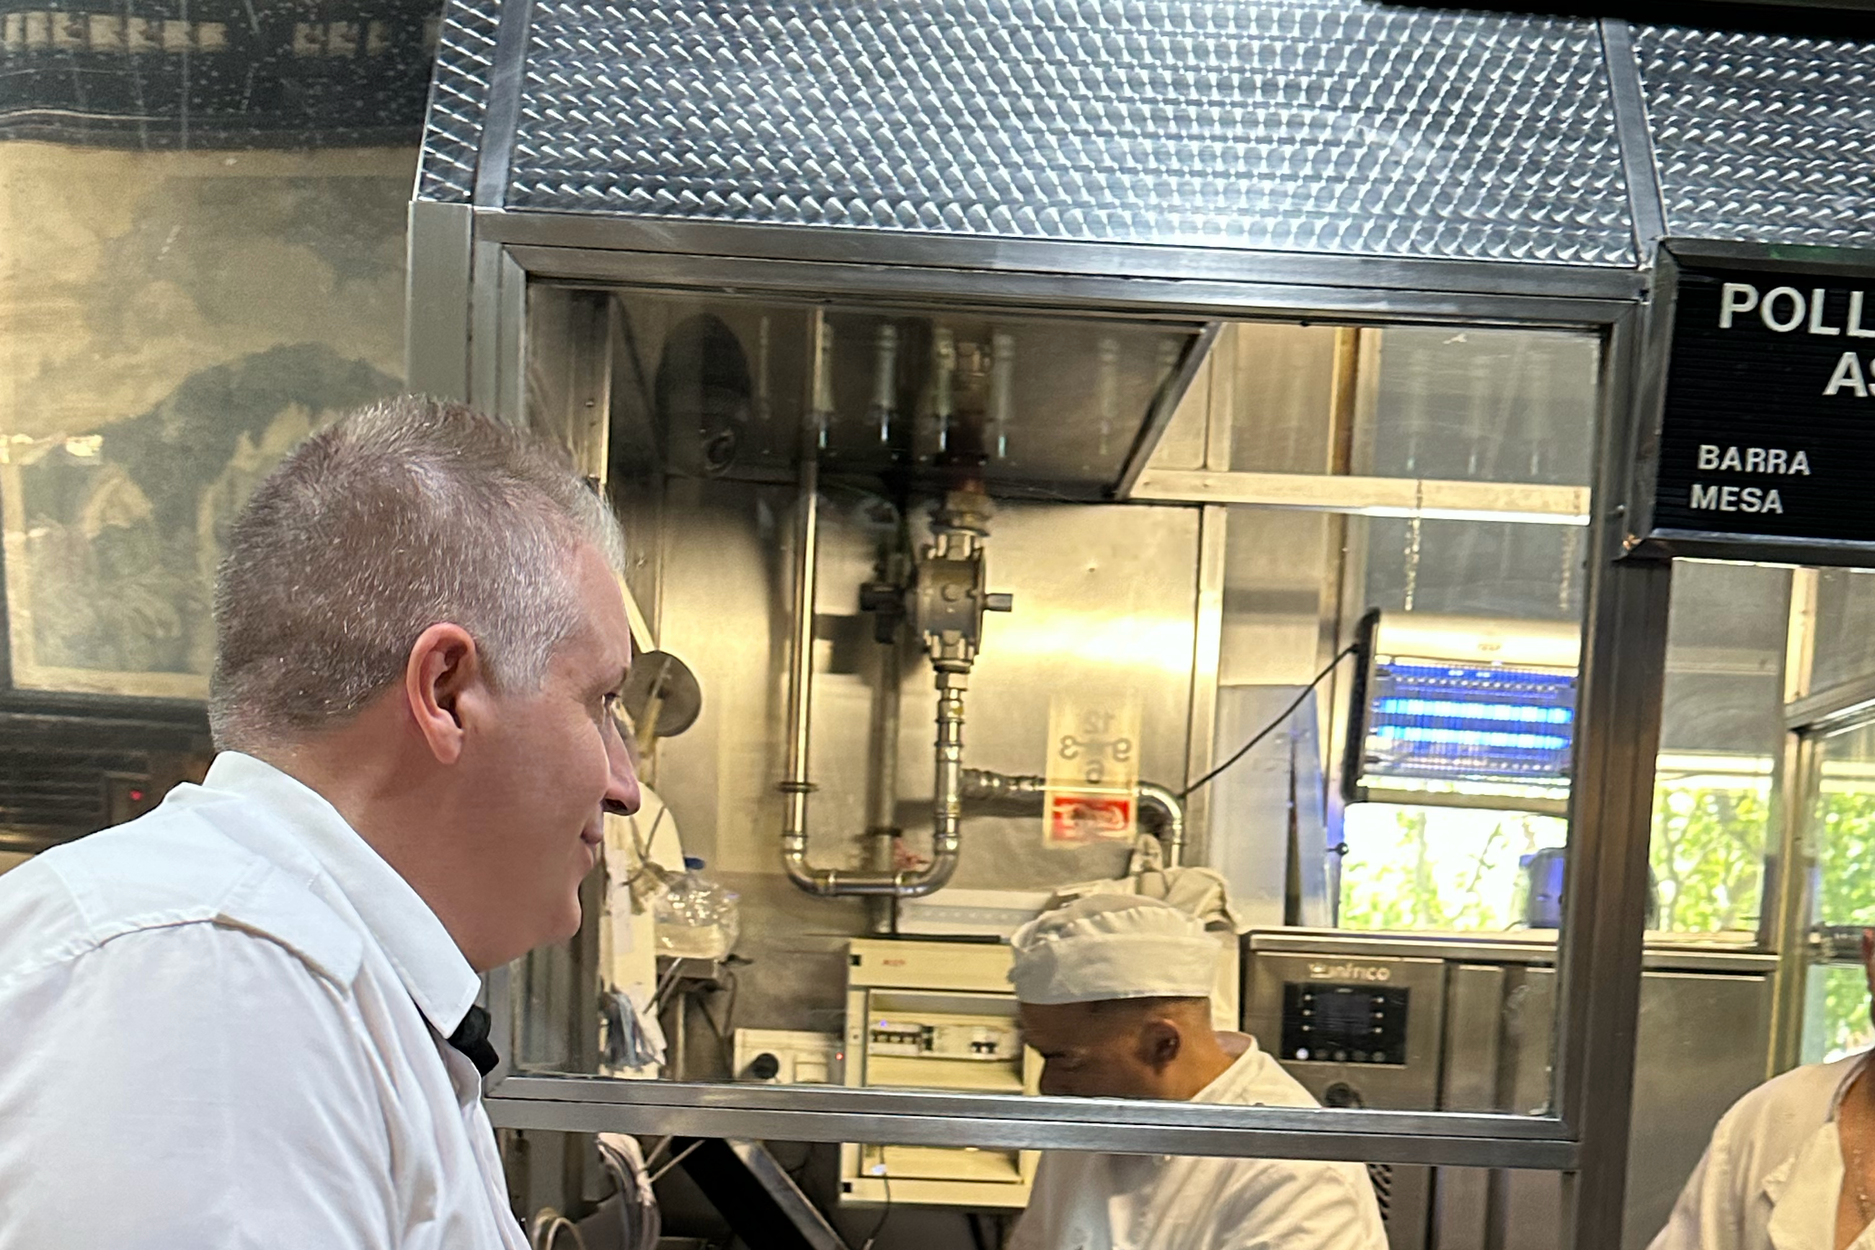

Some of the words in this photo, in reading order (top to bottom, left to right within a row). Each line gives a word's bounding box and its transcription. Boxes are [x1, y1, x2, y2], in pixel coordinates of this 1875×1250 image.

[1718, 282, 1875, 338] POLL
[1821, 351, 1875, 398] A
[1697, 444, 1811, 476] BARRA
[1689, 484, 1784, 514] MESA
